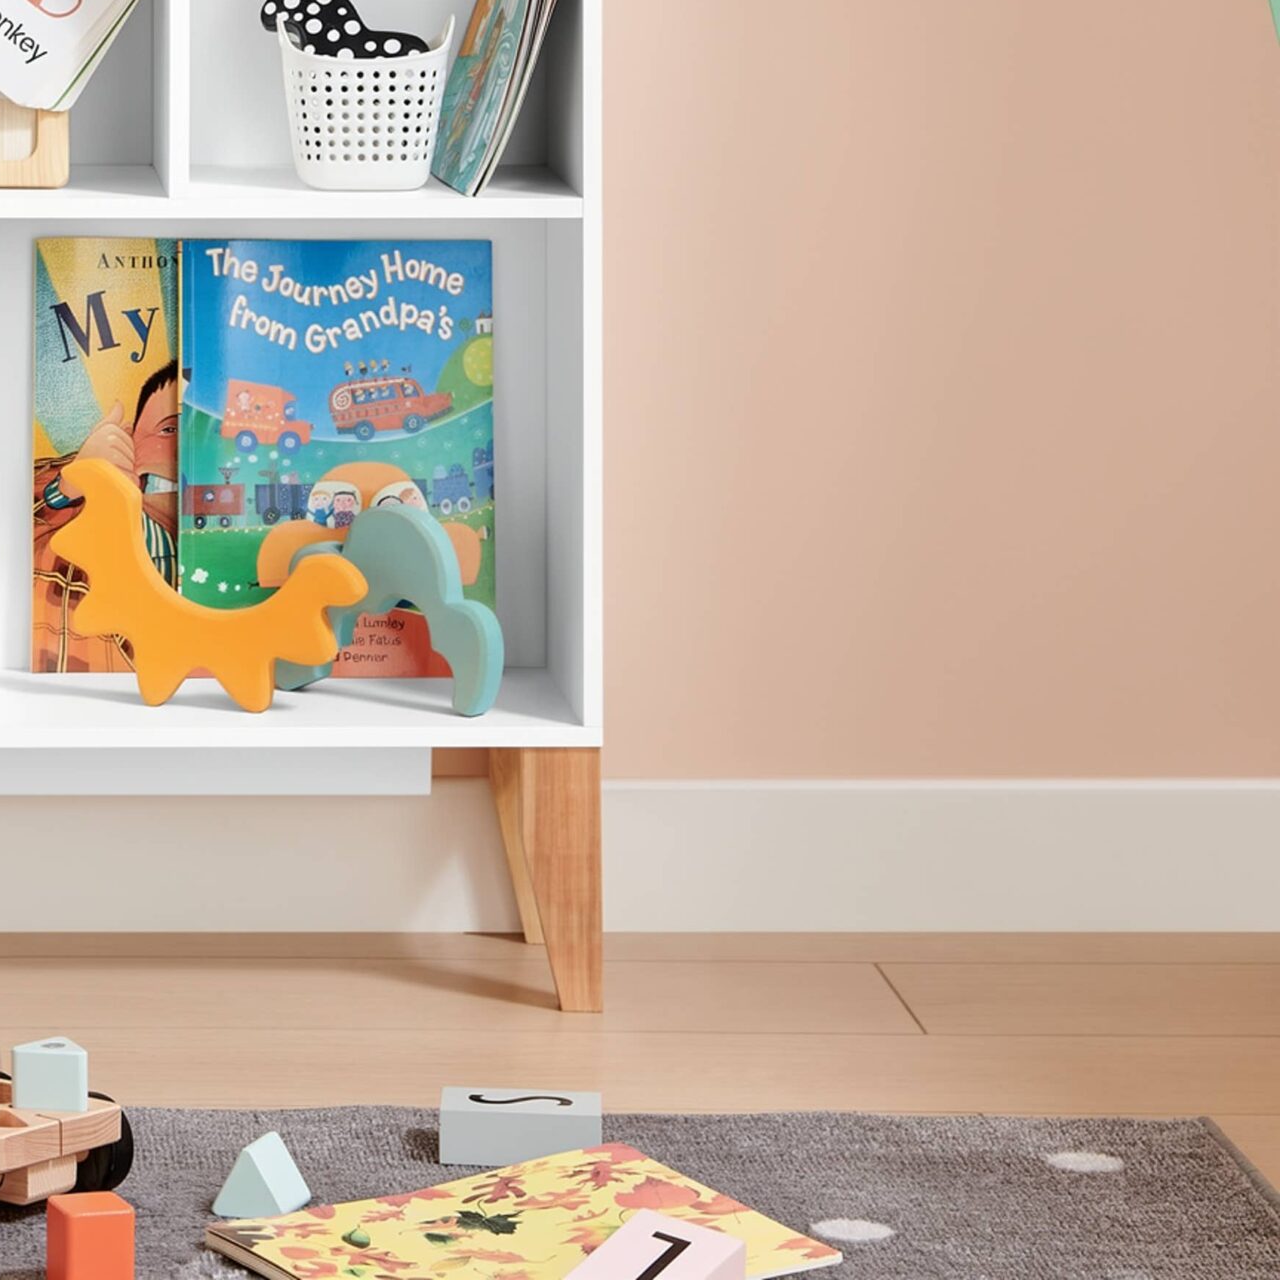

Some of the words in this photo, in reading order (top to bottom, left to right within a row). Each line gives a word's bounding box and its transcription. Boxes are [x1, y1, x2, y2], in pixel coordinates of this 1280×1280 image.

[205, 247, 259, 284] The
[261, 264, 379, 307] Journey
[380, 249, 465, 296] Home
[49, 290, 160, 364] My
[228, 294, 298, 351] from
[304, 296, 454, 354] Grandpa's
